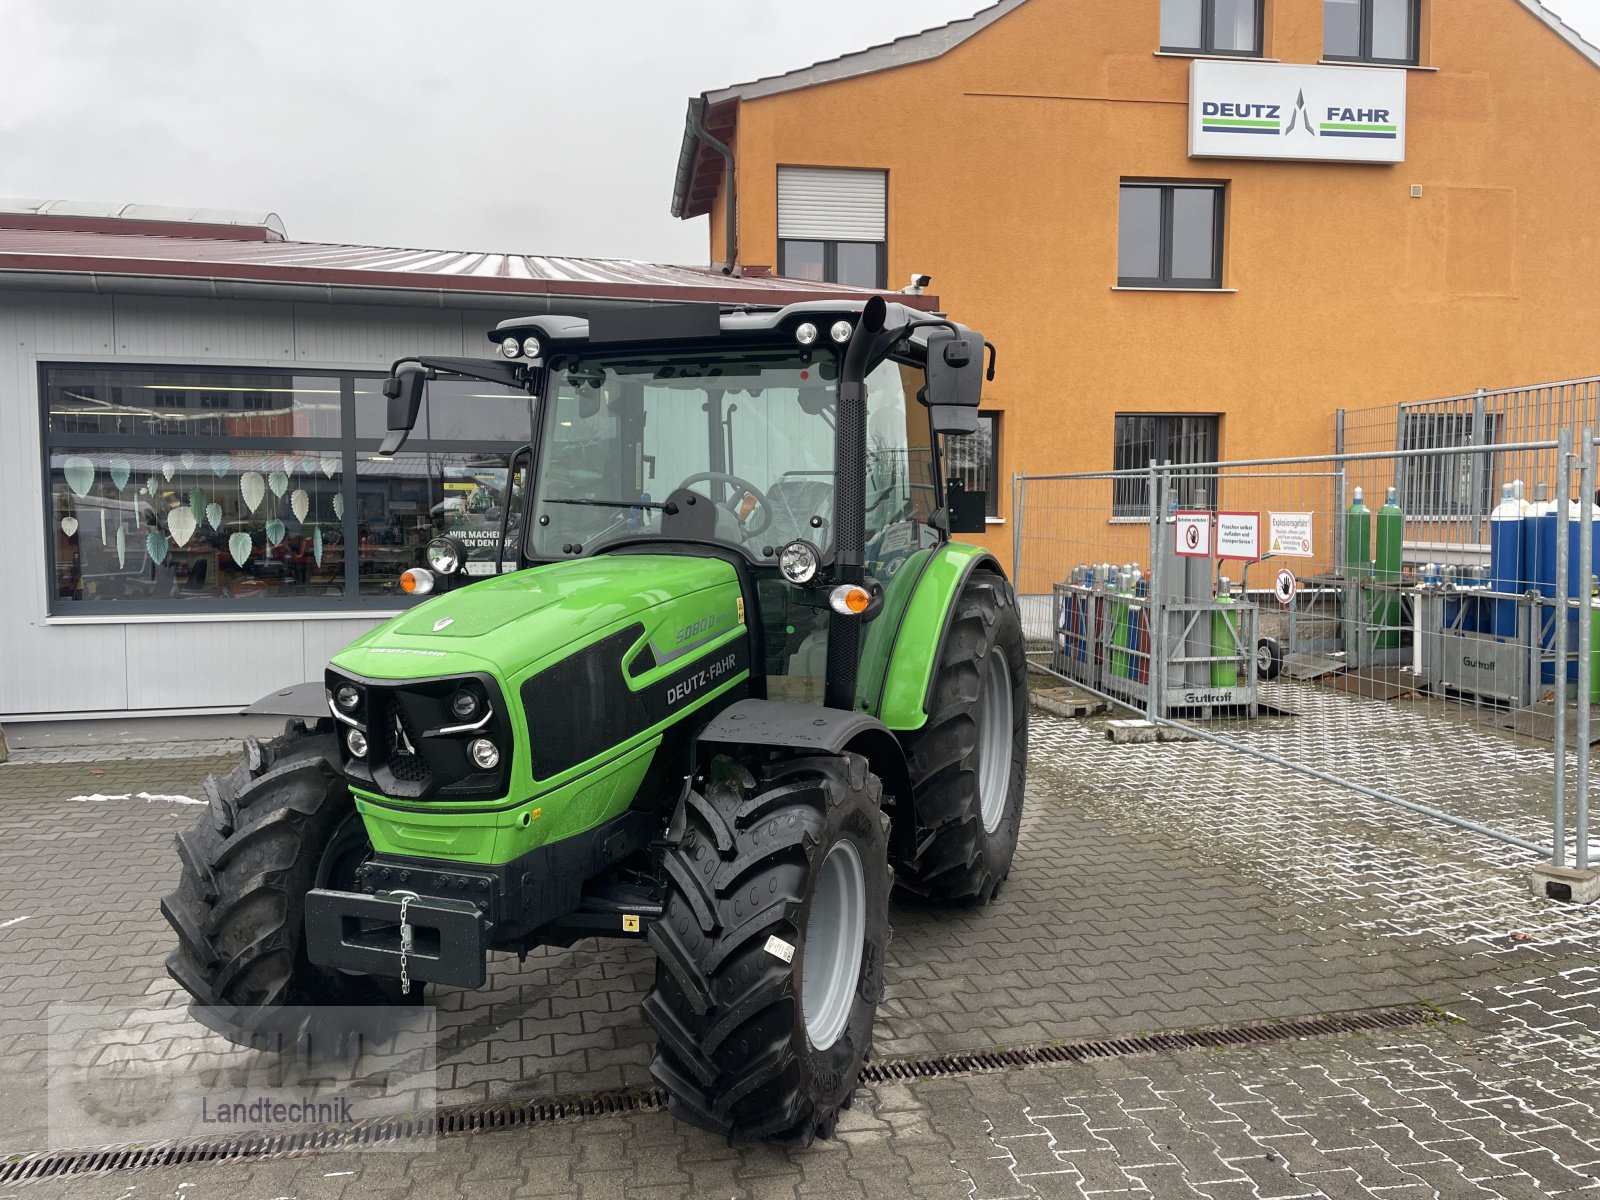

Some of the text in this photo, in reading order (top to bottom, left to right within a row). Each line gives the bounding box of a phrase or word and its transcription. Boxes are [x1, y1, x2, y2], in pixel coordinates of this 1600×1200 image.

[1202, 102, 1281, 119] DEUTZ
[1327, 107, 1390, 123] FAHR
[449, 530, 466, 539] WIR
[477, 539, 494, 547] DEN
